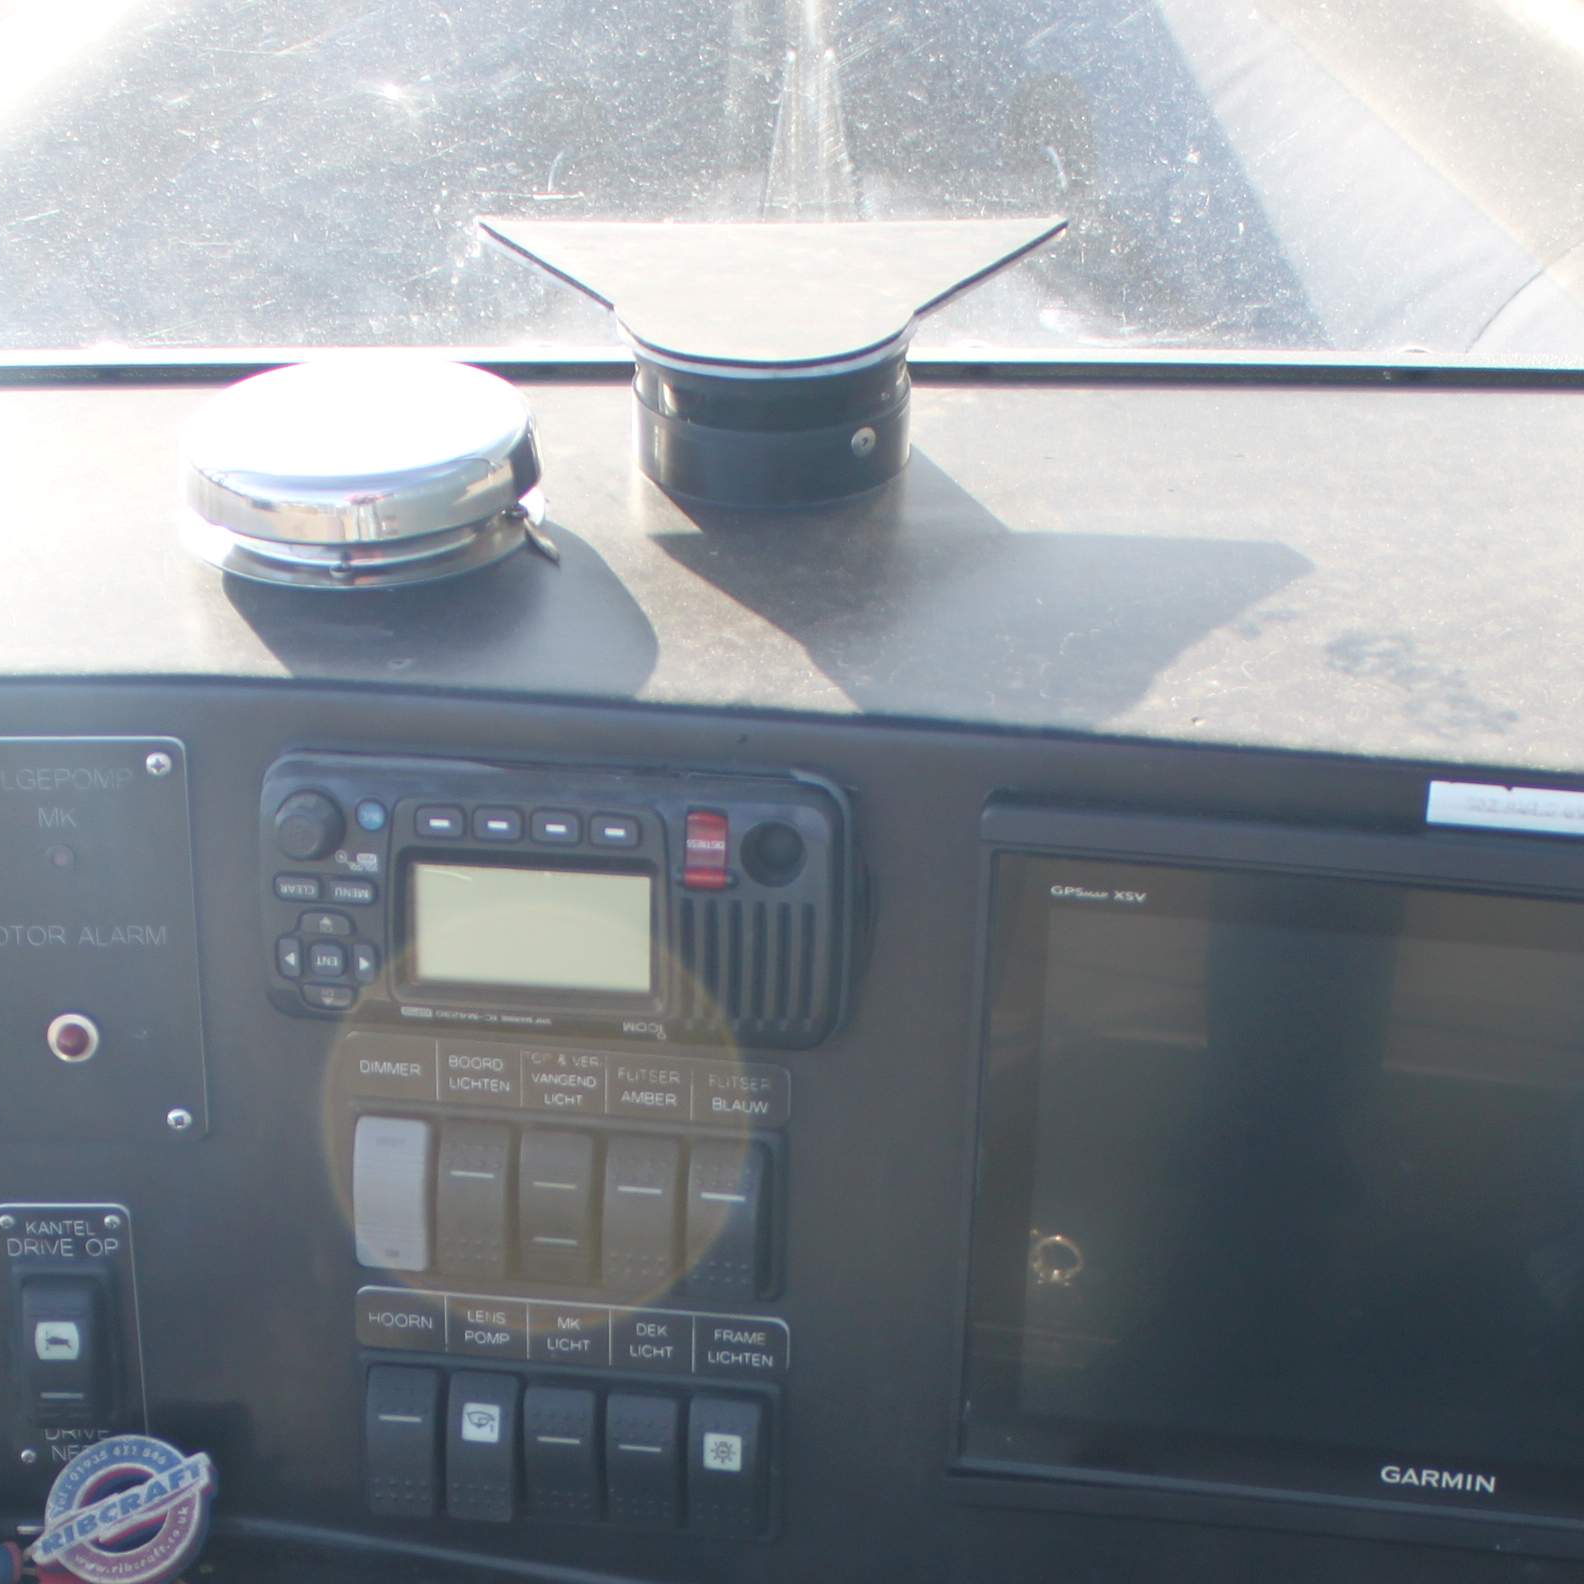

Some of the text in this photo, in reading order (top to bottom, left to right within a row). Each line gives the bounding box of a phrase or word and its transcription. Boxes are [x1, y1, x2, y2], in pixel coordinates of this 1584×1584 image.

[38, 807, 78, 828] MK
[279, 883, 316, 896] CLEAR
[334, 886, 370, 899] MENU
[1113, 889, 1147, 903] XSV
[78, 925, 167, 947] ALARM
[358, 1060, 421, 1077] DIMMER
[448, 1055, 504, 1072] BOORD
[449, 1076, 510, 1093] LICHTEN
[531, 1072, 597, 1089] VANGEND
[617, 1066, 681, 1086] FLITSER
[709, 1073, 771, 1092] FLITSER
[544, 1092, 583, 1106] LICHT
[621, 1090, 677, 1107] AMBER
[711, 1096, 769, 1114] BLAUW
[25, 1220, 96, 1237] KANTEL
[6, 1237, 119, 1257] DRIVE OP
[368, 1311, 433, 1329] HOORN
[467, 1310, 506, 1326] LENS
[557, 1316, 581, 1332] MK
[464, 1329, 510, 1346] POMP
[636, 1322, 668, 1338] DEK
[714, 1329, 767, 1346] FRAME
[547, 1337, 592, 1353] LICHT
[629, 1344, 673, 1360] LICHT
[708, 1350, 774, 1368] LICHTEN
[1380, 1466, 1497, 1494] GARMIN
[40, 1459, 208, 1555] RIBCRAFT
